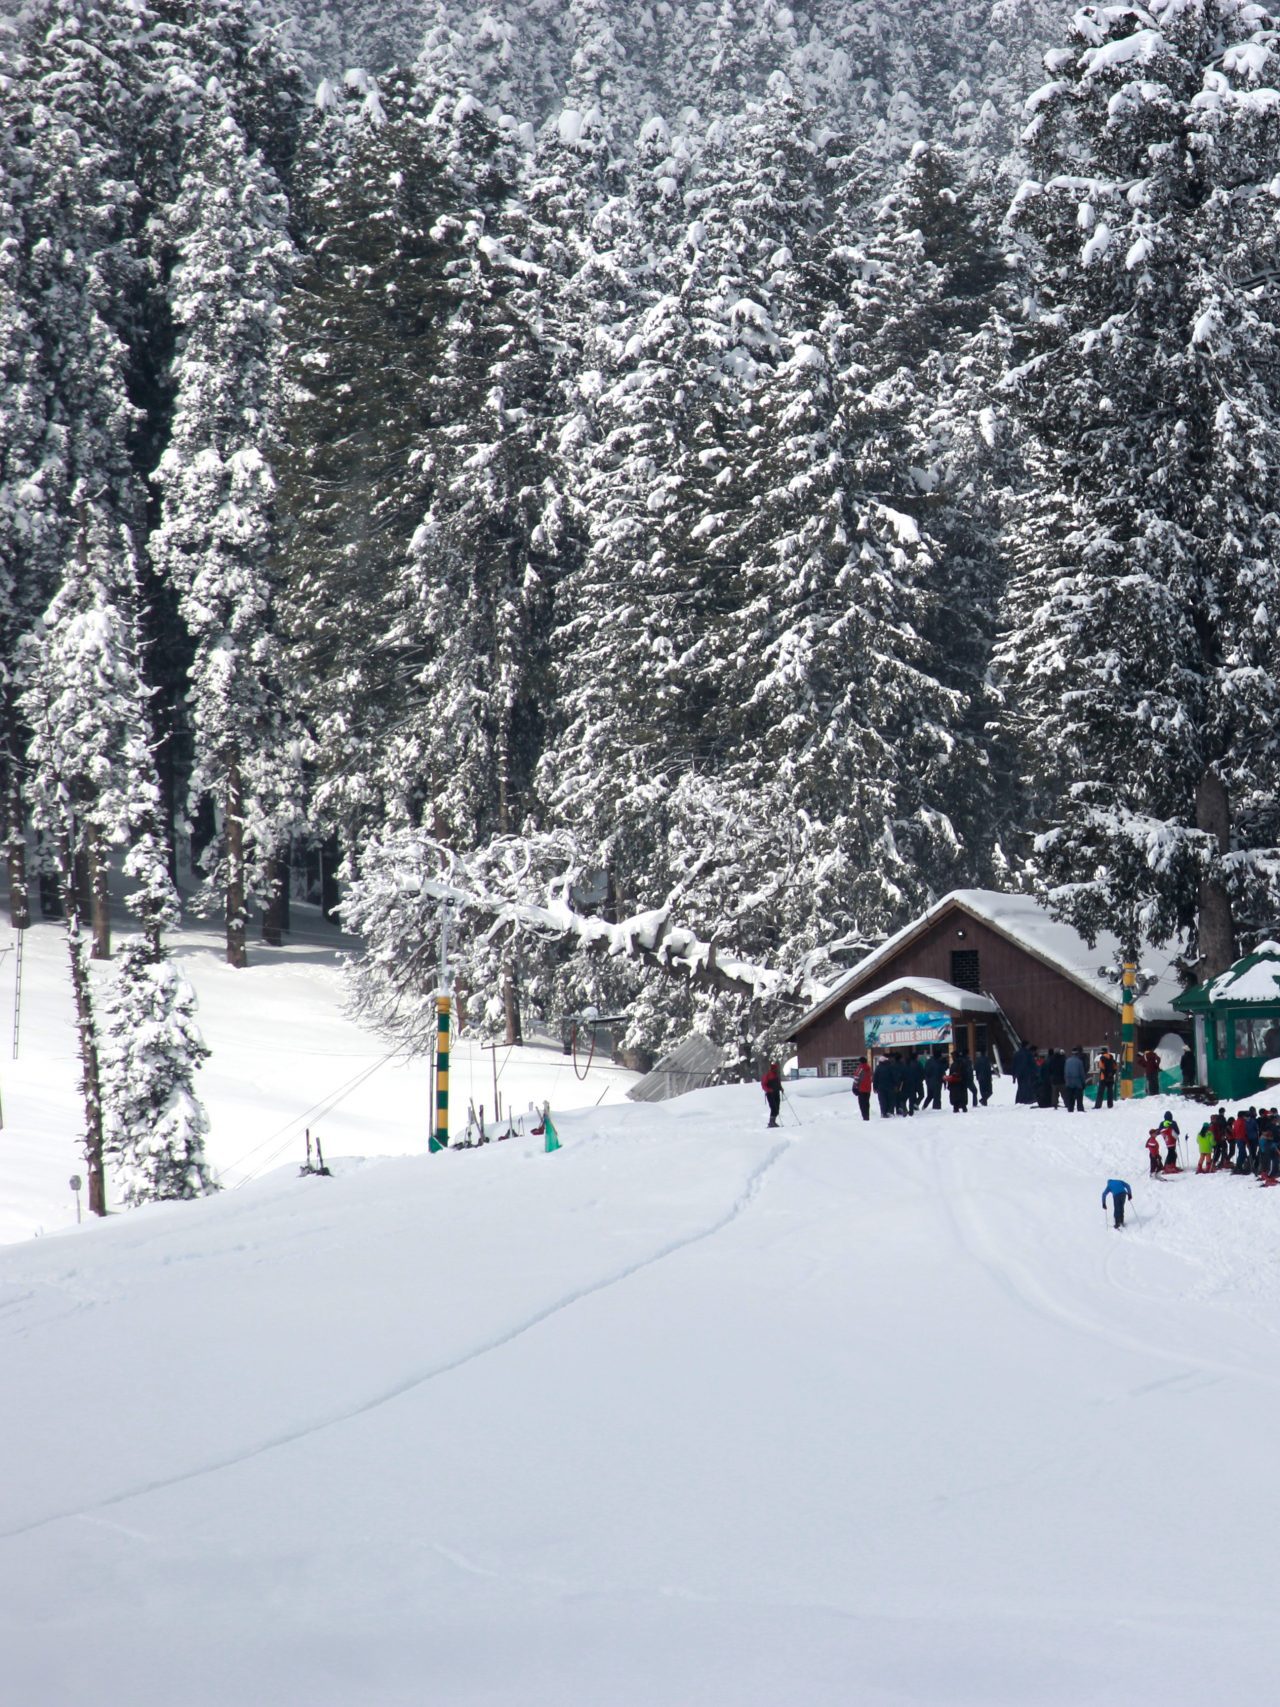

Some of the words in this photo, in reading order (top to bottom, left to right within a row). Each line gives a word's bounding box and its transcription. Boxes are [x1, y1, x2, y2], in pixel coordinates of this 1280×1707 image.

[880, 1033, 894, 1044] SKI
[896, 1031, 914, 1042] HIRE
[916, 1029, 938, 1041] SHOP
